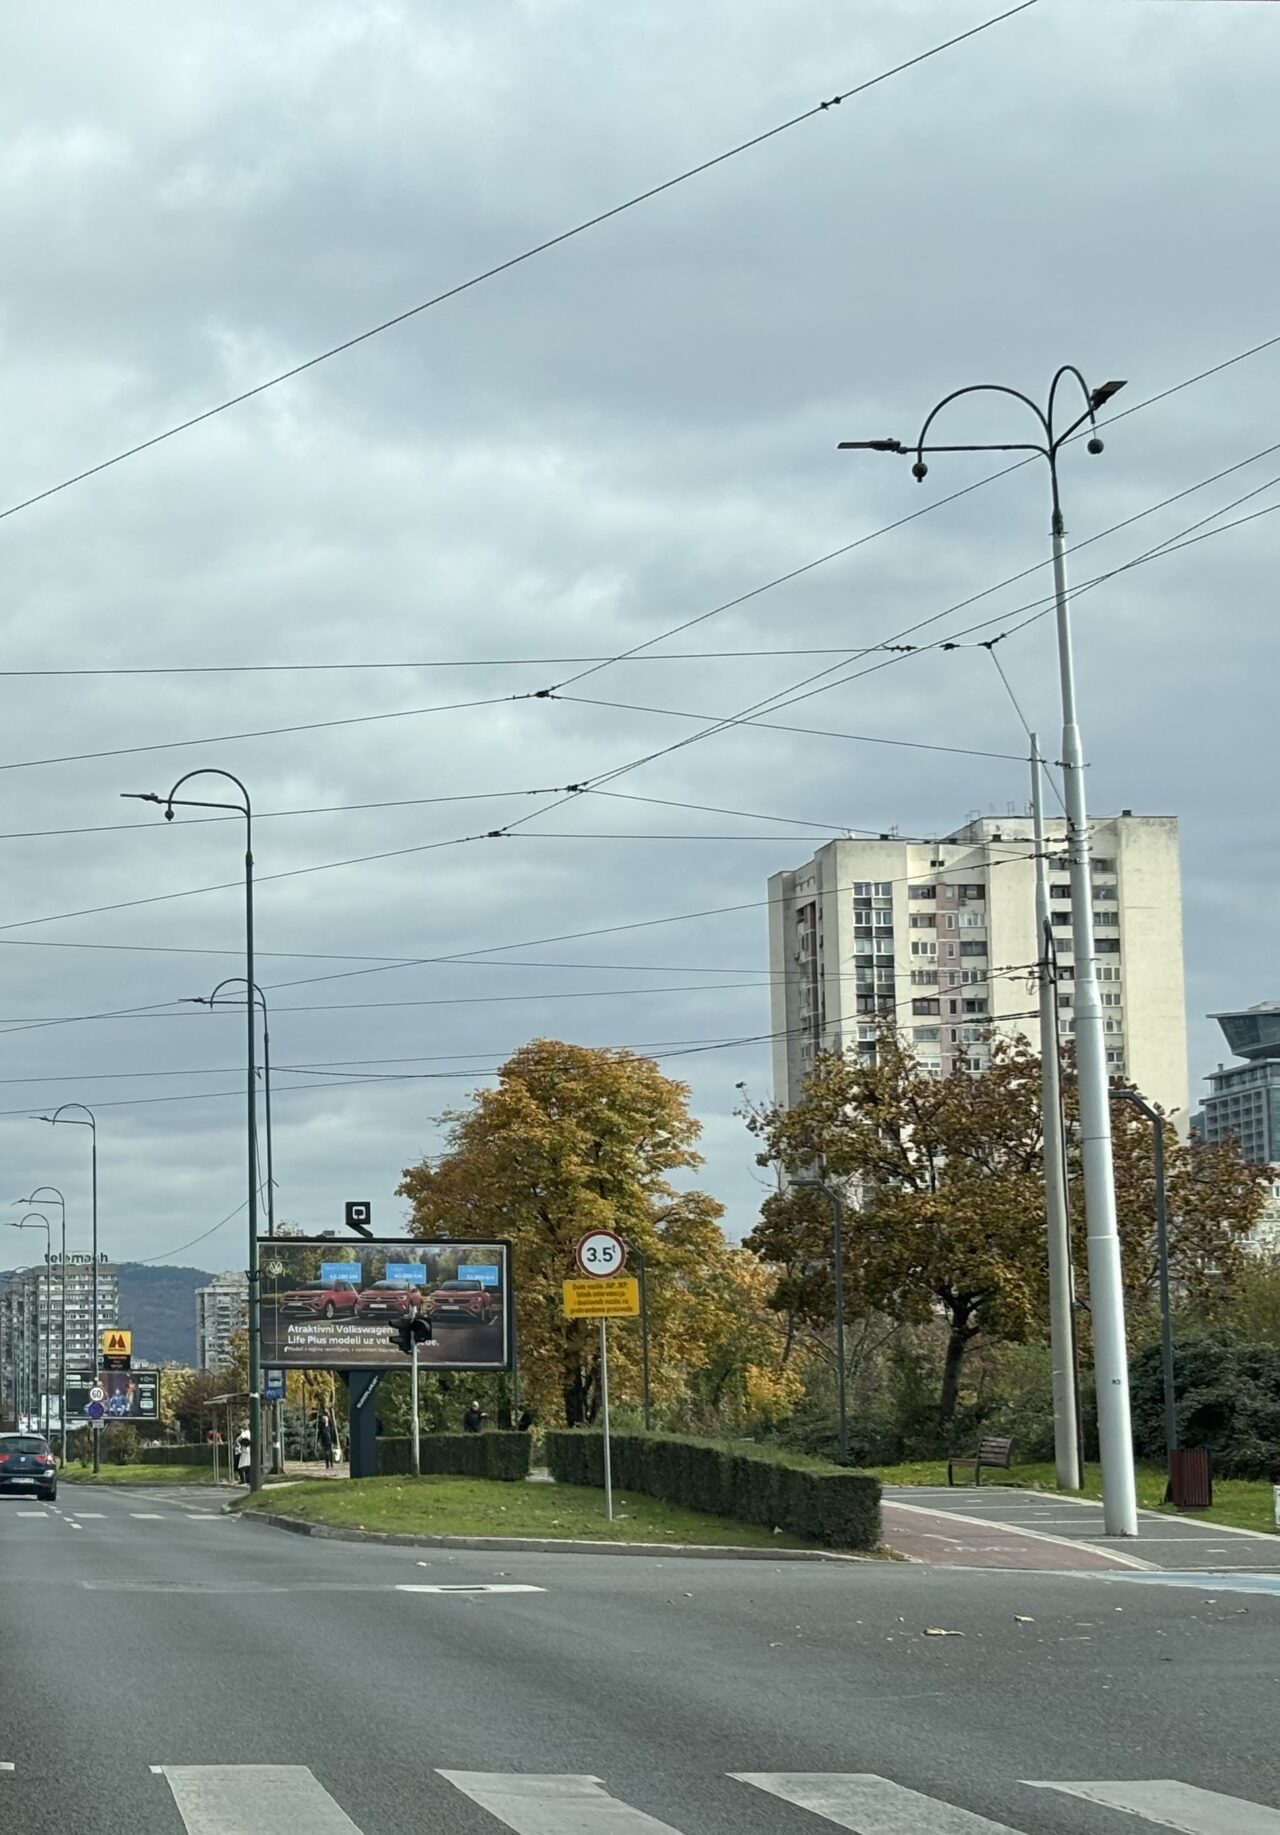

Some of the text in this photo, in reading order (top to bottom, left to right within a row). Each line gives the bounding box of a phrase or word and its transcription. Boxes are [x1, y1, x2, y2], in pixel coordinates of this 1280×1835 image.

[287, 1324, 394, 1336] Atraktivni Volkswagen
[287, 1336, 305, 1345] Life
[307, 1336, 327, 1345] Plus
[328, 1336, 361, 1345] modeli
[363, 1337, 375, 1345] uz
[91, 1389, 102, 1399] 60
